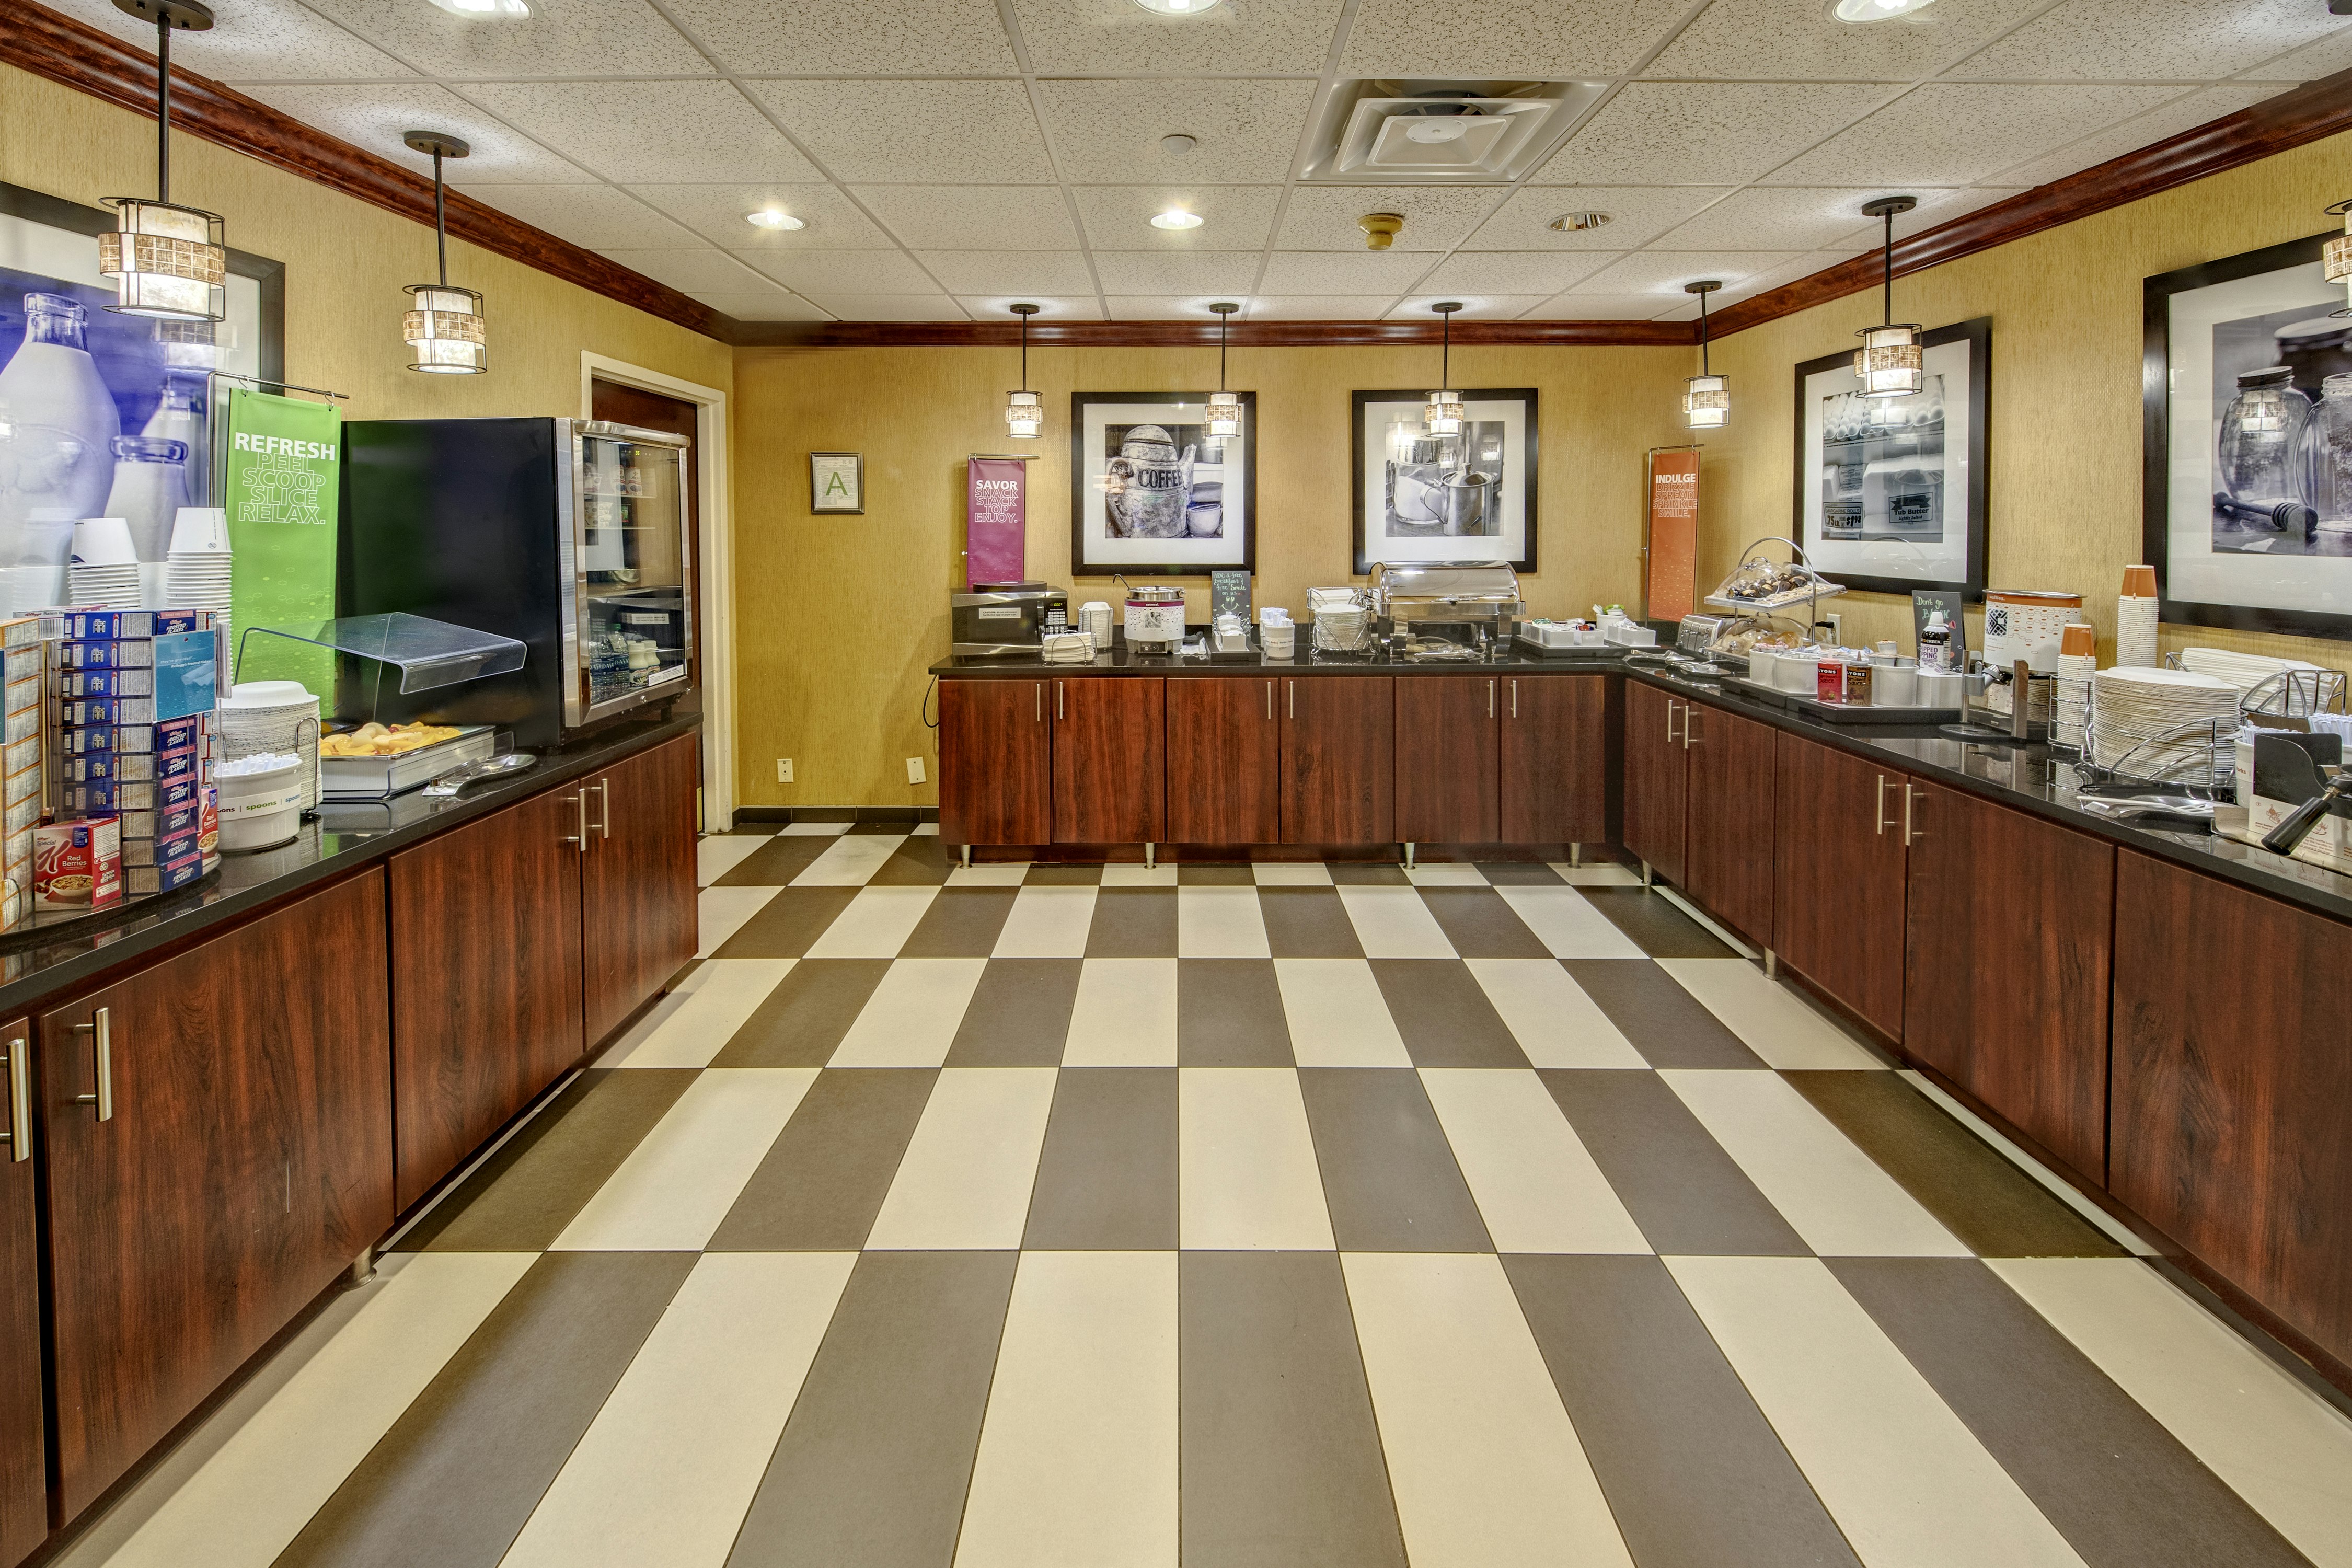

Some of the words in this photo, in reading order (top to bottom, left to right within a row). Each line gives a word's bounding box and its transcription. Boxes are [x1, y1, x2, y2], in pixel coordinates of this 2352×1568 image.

[235, 432, 335, 461] REFRESH
[257, 452, 314, 474] PEEL
[243, 468, 326, 491] SCOOP
[826, 472, 848, 496] A
[1138, 469, 1182, 488] COFFEE
[1656, 473, 1696, 483] INDULGE
[976, 480, 1017, 490] SAVOR
[1656, 482, 1695, 492] DRIZZLE
[250, 486, 317, 507] SLICE
[975, 488, 1019, 498] SNACK
[1655, 491, 1695, 500] SPREAD
[976, 497, 1017, 506] STACK
[1652, 499, 1698, 510] SPRINKLE
[238, 502, 325, 525] RELAX.
[984, 505, 1009, 514] TOP
[1658, 509, 1691, 518] SMILE.
[975, 513, 1018, 523] ENJOY.
[1916, 596, 1933, 605] Don't
[1935, 599, 1943, 609] go
[246, 801, 277, 811] spoons
[285, 794, 301, 803] spoon
[168, 841, 188, 854] FROSTED
[169, 847, 186, 857] FLAKES
[36, 840, 72, 874] K
[173, 868, 193, 881] FROSTED
[174, 873, 191, 884] FLAKES
